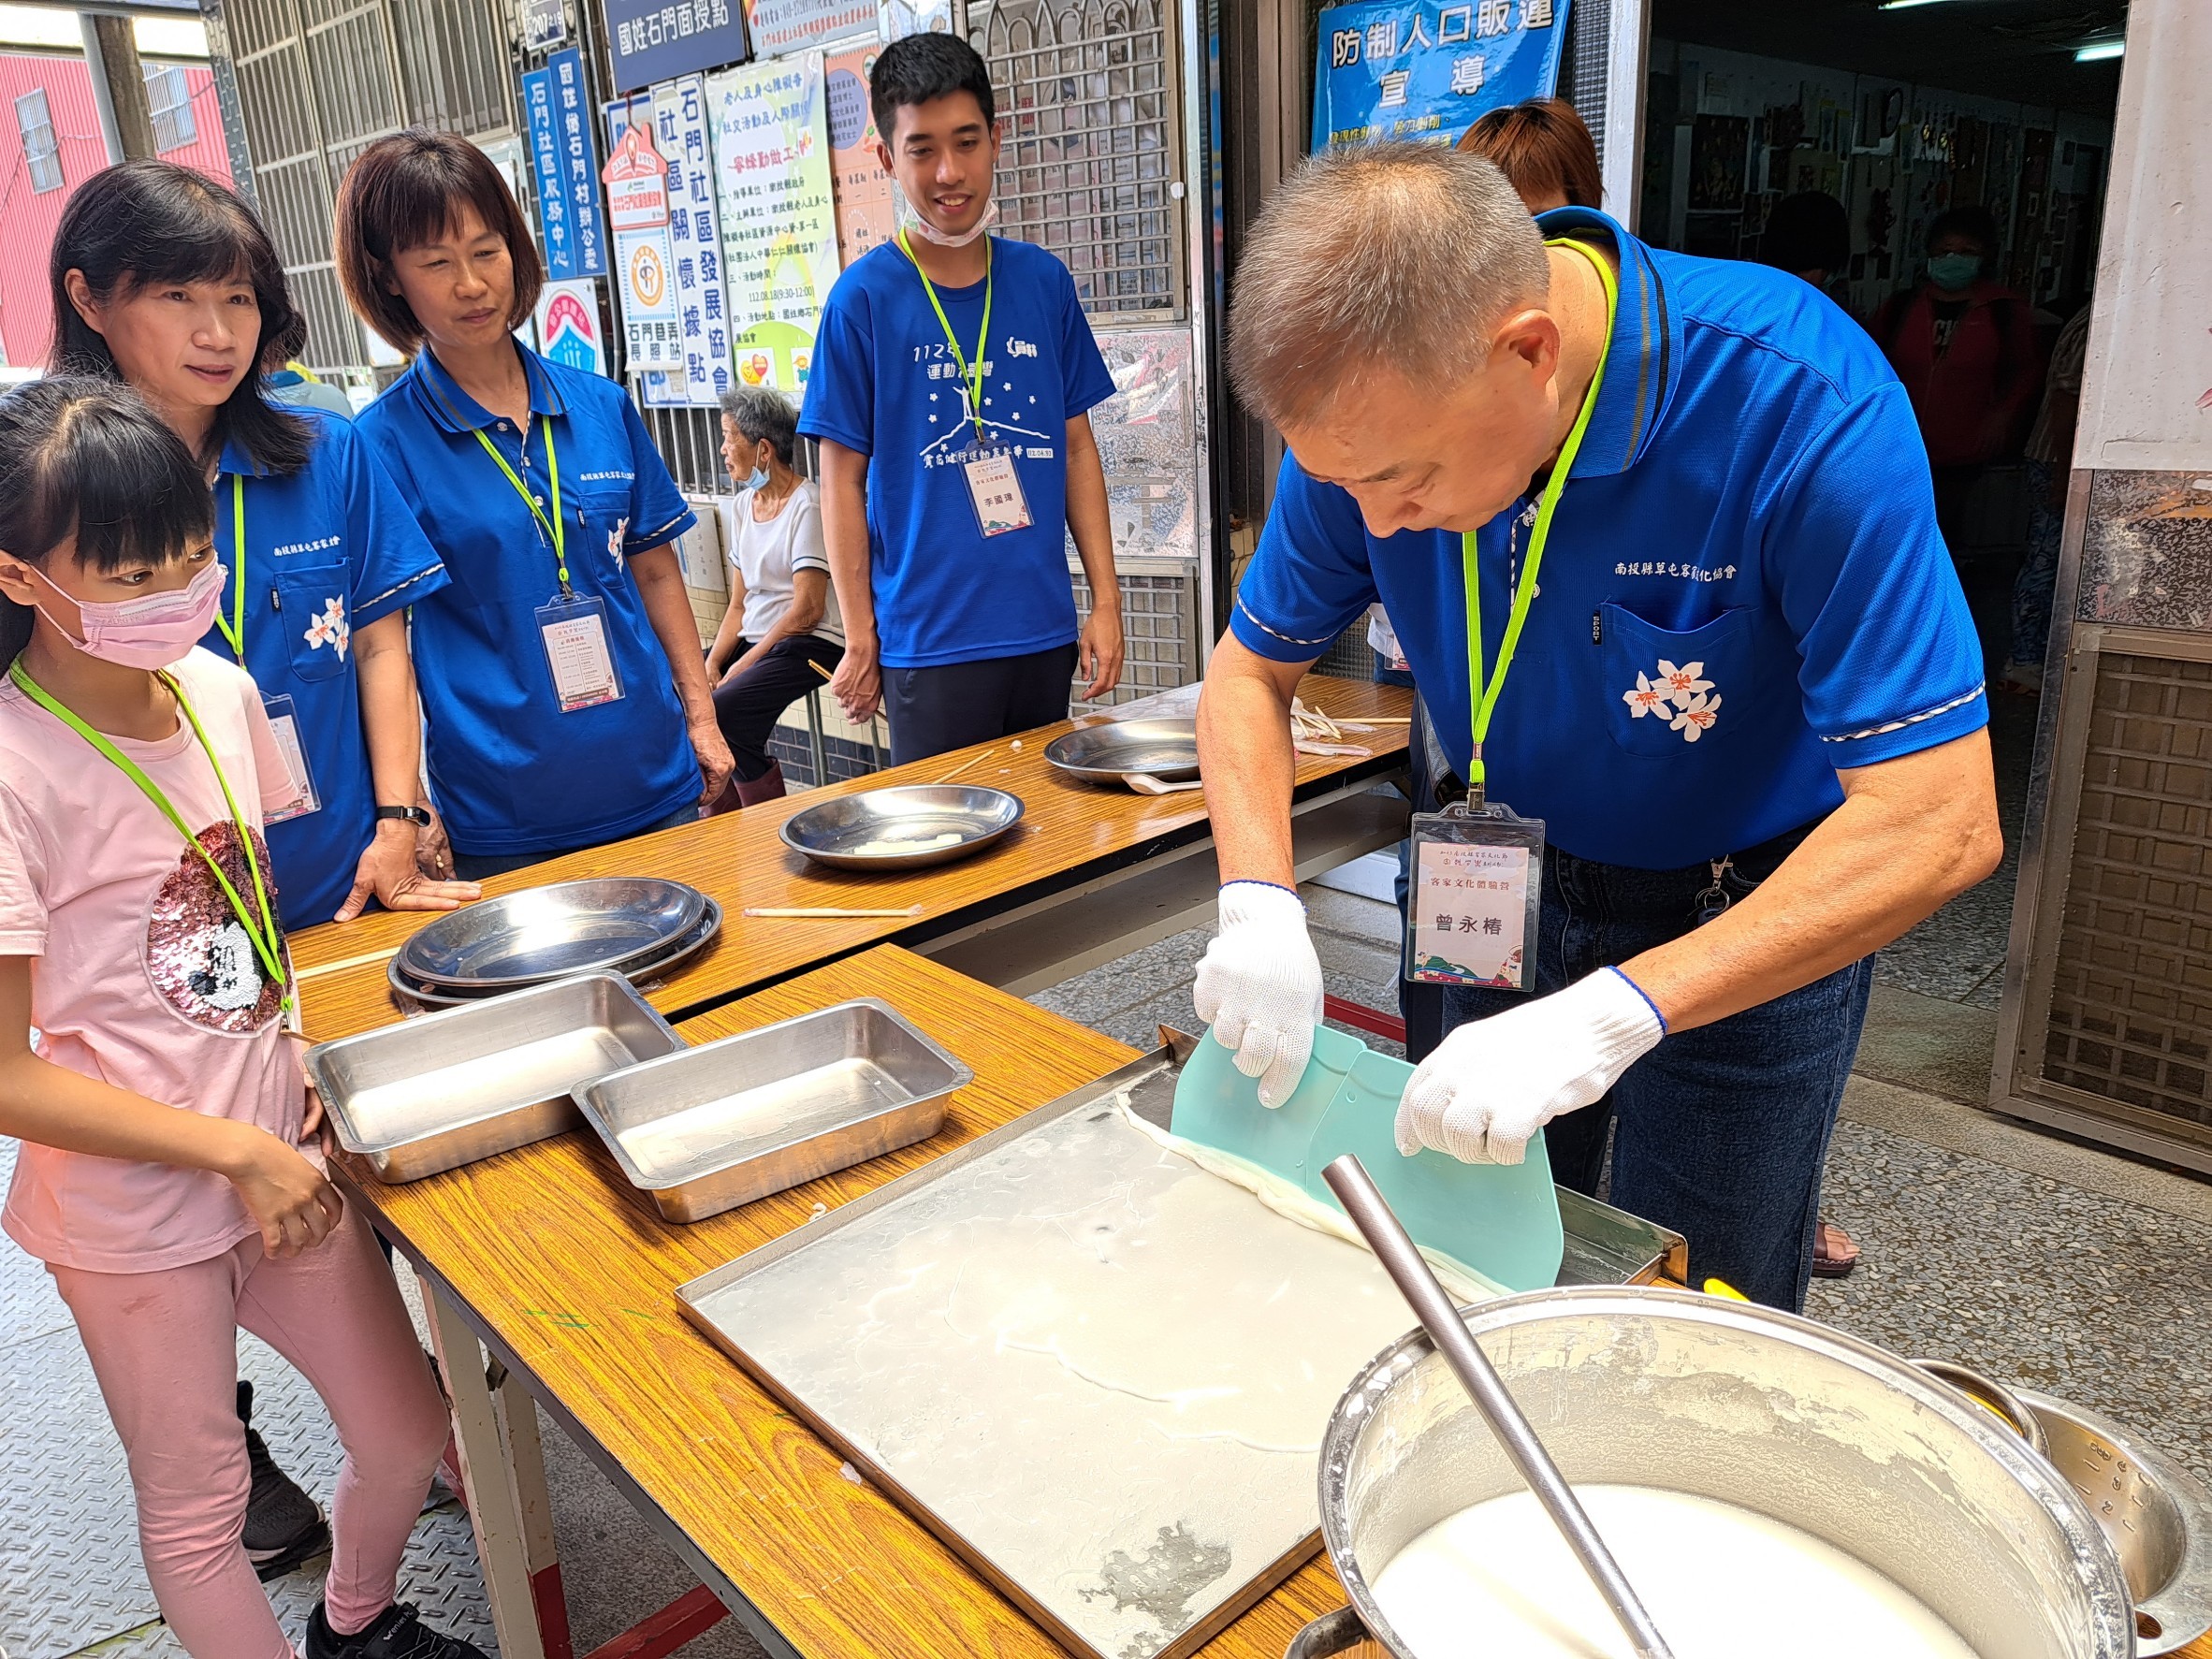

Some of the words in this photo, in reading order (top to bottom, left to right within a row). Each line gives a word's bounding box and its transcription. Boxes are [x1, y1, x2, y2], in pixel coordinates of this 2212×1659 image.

[617, 0, 730, 57] 國姓石門面授點
[1332, 0, 1554, 68] 防制人口販運
[530, 80, 570, 269] 石門社區服務中心
[658, 108, 706, 385] 社區關懷據點
[679, 86, 729, 396] 石門社區發展協會
[627, 322, 679, 342] 石門巷弄
[630, 342, 681, 362] 長照站
[1430, 877, 1510, 891] 客家文化體驗營
[1435, 913, 1503, 936] 曾永椿
